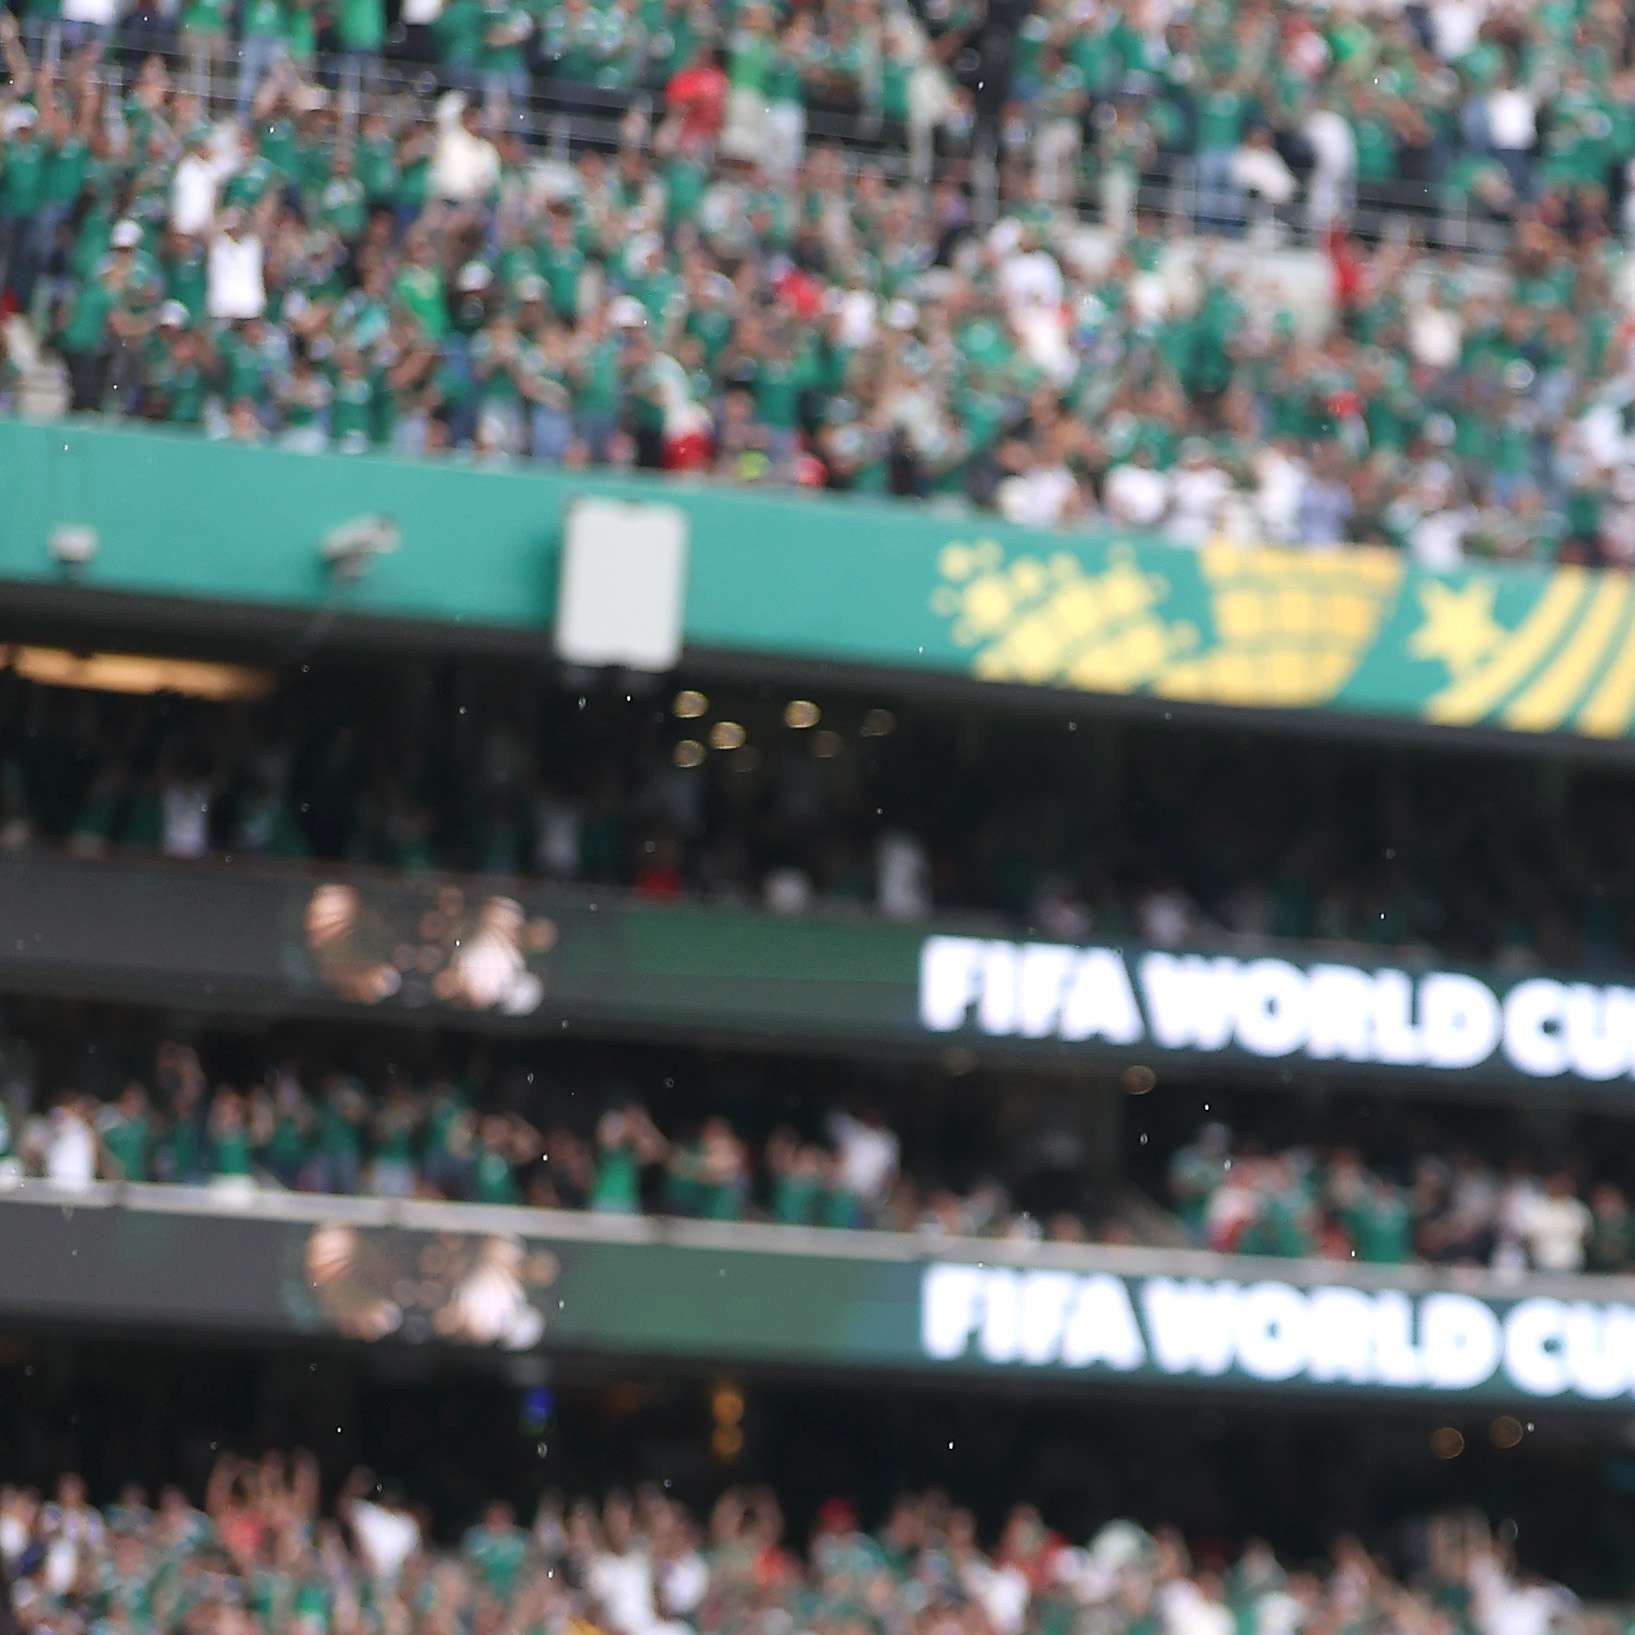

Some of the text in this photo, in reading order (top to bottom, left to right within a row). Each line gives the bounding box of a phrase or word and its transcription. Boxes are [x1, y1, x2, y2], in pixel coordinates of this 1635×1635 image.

[920, 936, 1142, 1043] FIFA
[1141, 952, 1502, 1070] WORLD
[920, 1262, 1144, 1369] FIFA
[1142, 1277, 1503, 1390] WORLD
